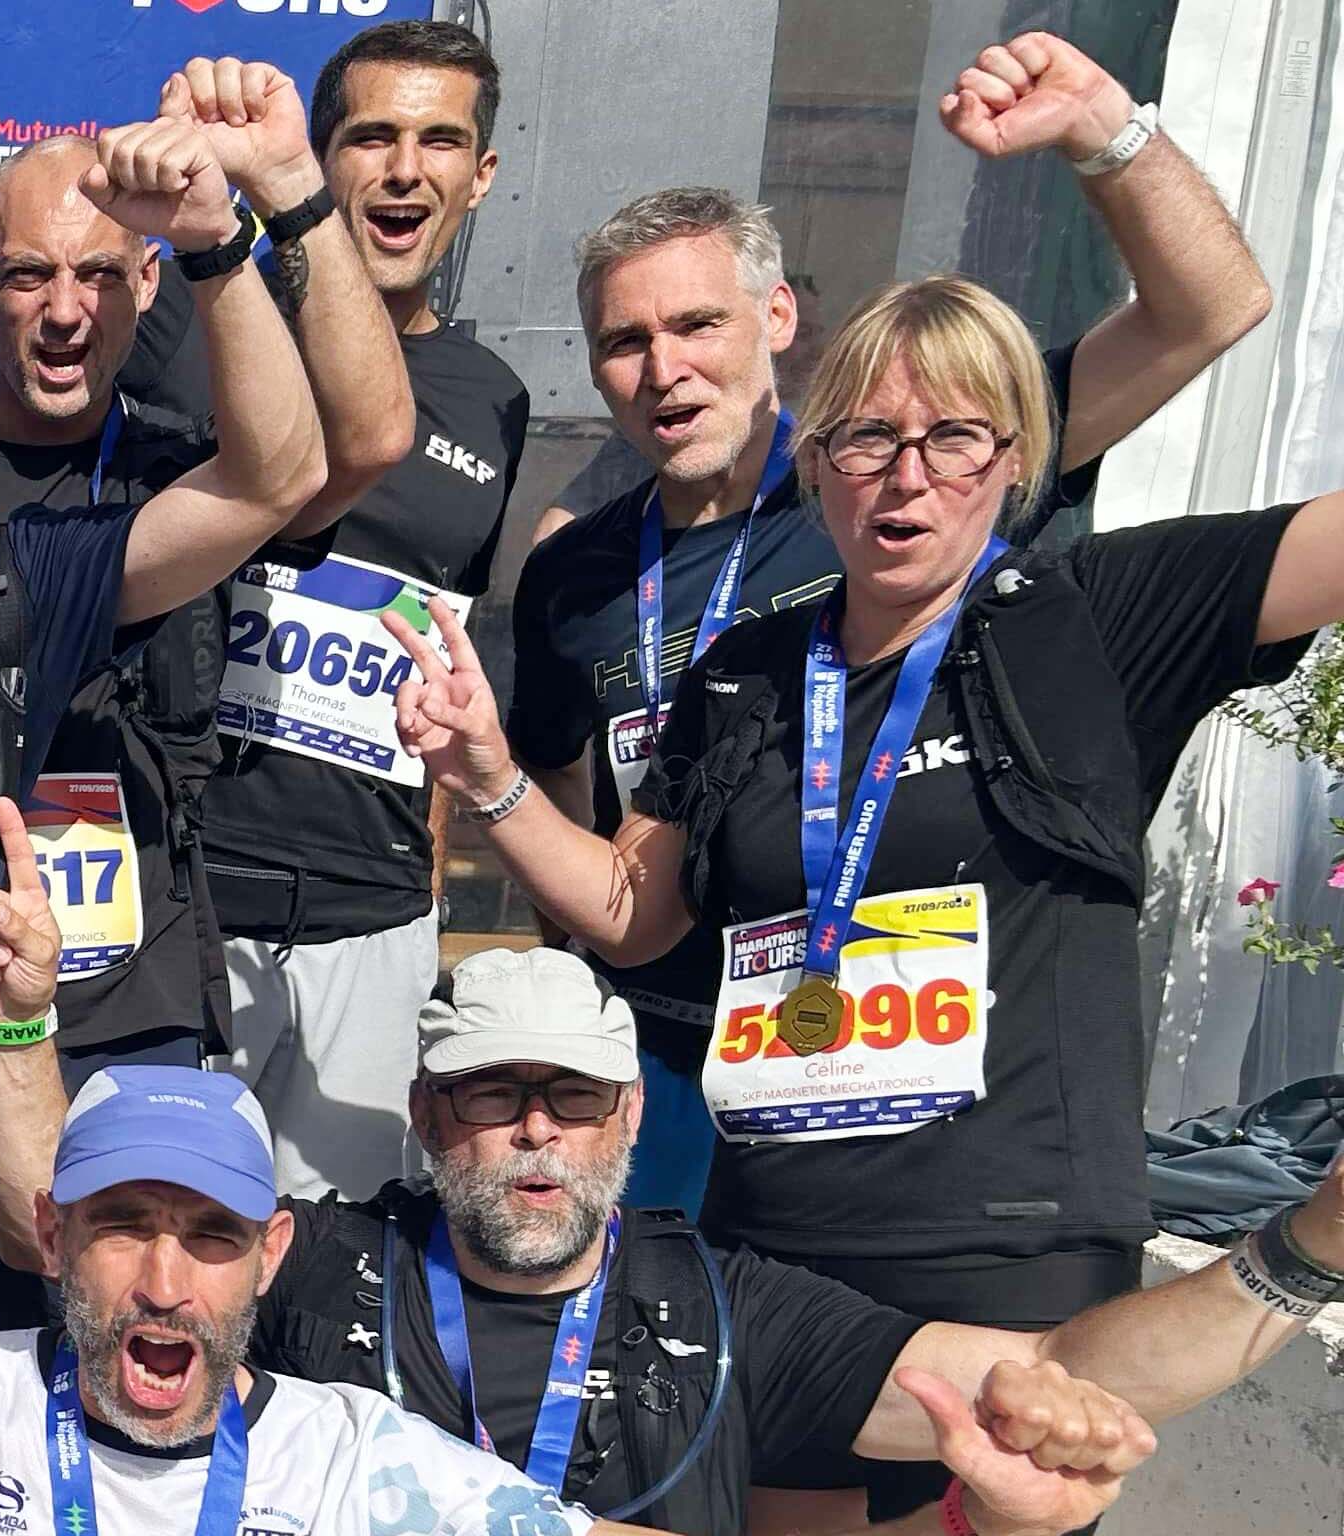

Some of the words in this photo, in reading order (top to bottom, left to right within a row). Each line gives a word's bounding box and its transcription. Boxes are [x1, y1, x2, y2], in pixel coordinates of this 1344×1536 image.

[425, 433, 496, 484] SKF
[227, 609, 415, 707] 20654
[291, 683, 347, 713] Thomas
[310, 710, 380, 739] MECHATRONICS
[833, 834, 867, 908] FINISHER
[855, 799, 878, 835] DUO
[60, 931, 107, 944] TRONICS
[734, 928, 808, 957] MARATHON
[742, 947, 808, 975] TOURS
[804, 1060, 865, 1079] Céline
[741, 1091, 764, 1104] SKF
[763, 1084, 829, 1101] MAGNETIC
[829, 1075, 936, 1098] MECHATRONICS
